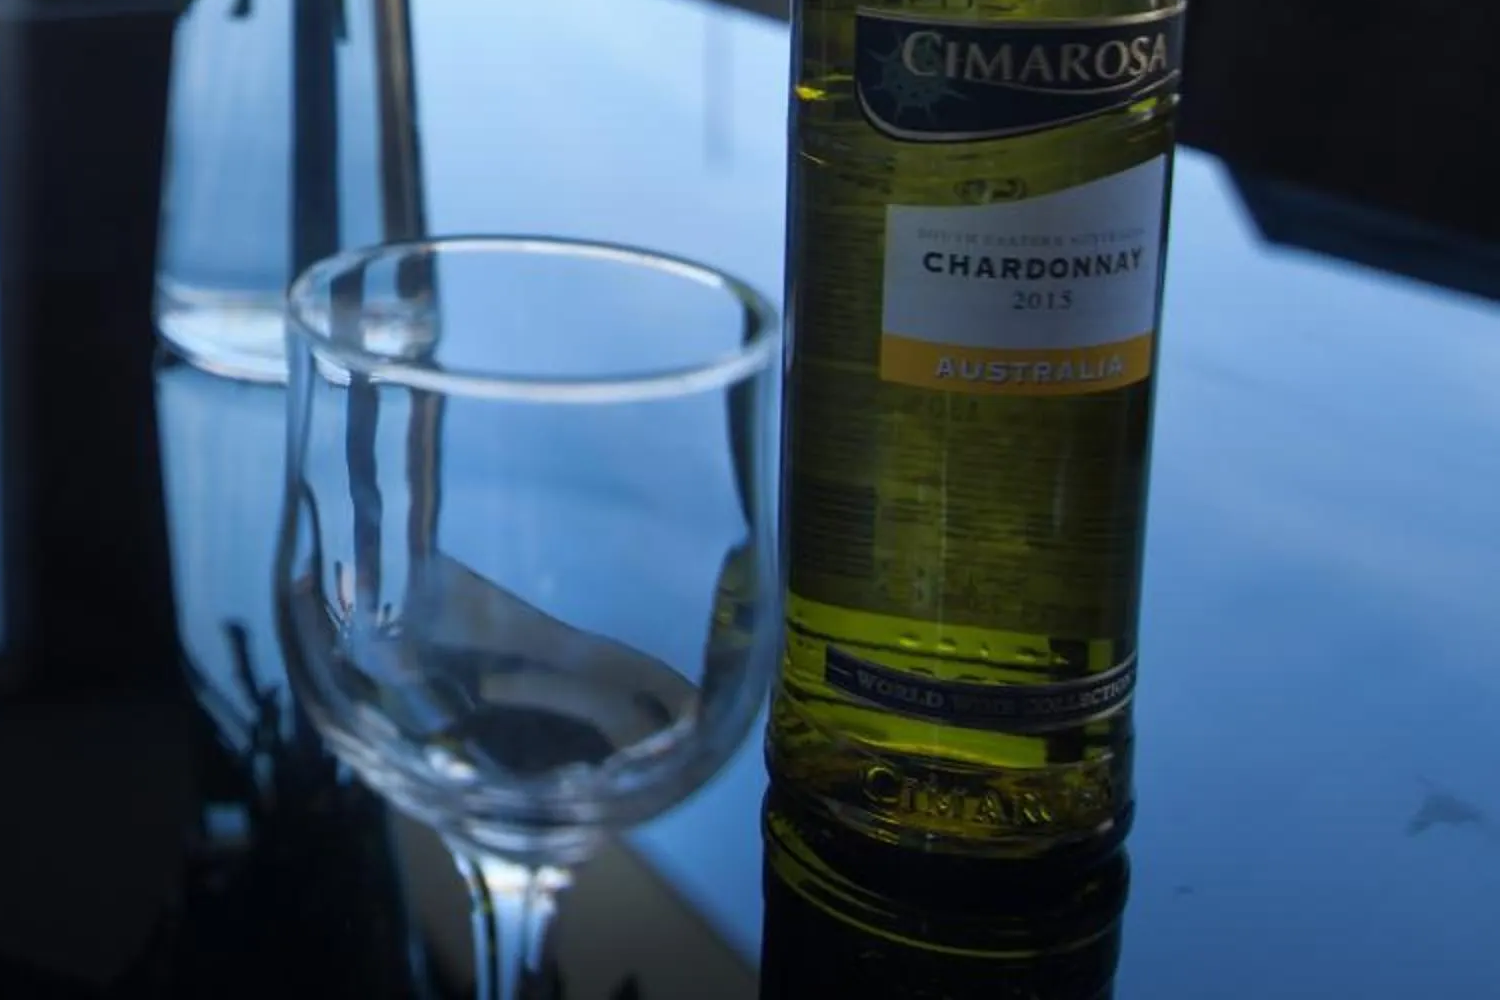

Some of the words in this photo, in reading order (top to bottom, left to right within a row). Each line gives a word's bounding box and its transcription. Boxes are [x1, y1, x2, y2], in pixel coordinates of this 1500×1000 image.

[902, 31, 1168, 82] CIMAROSA
[922, 246, 1142, 279] CHARDONNAY
[1012, 290, 1073, 310] 2015
[935, 354, 1124, 382] AUSTRALIA
[856, 668, 946, 707] WORLD
